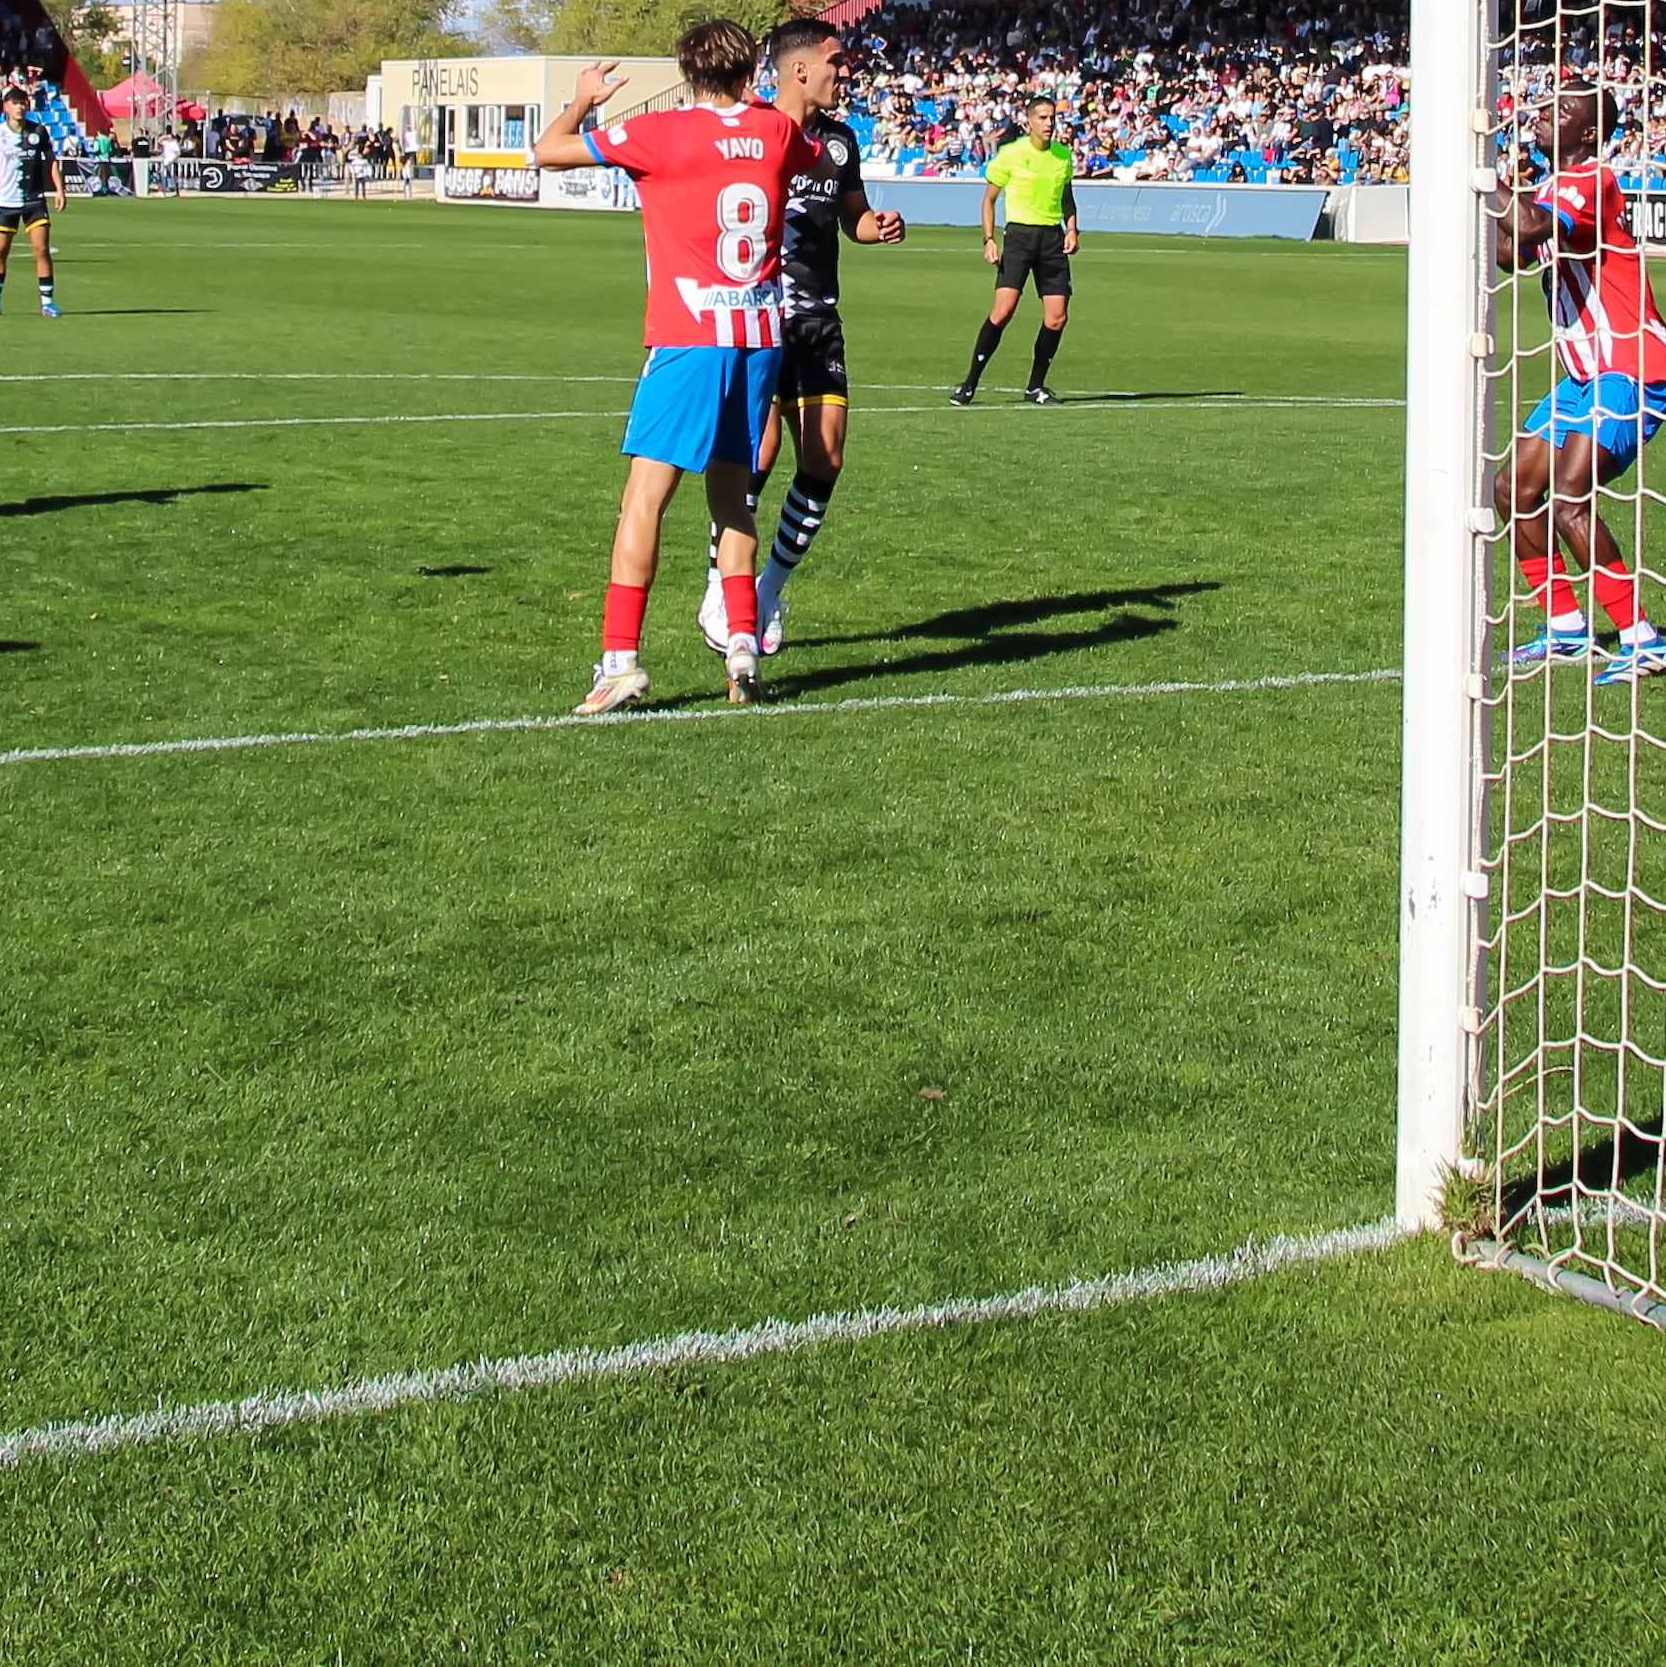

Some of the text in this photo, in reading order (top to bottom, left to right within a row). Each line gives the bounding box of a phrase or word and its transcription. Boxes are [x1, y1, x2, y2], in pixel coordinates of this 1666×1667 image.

[412, 67, 479, 97] PANELAIS
[715, 137, 764, 161] YAYO
[717, 183, 769, 282] 8
